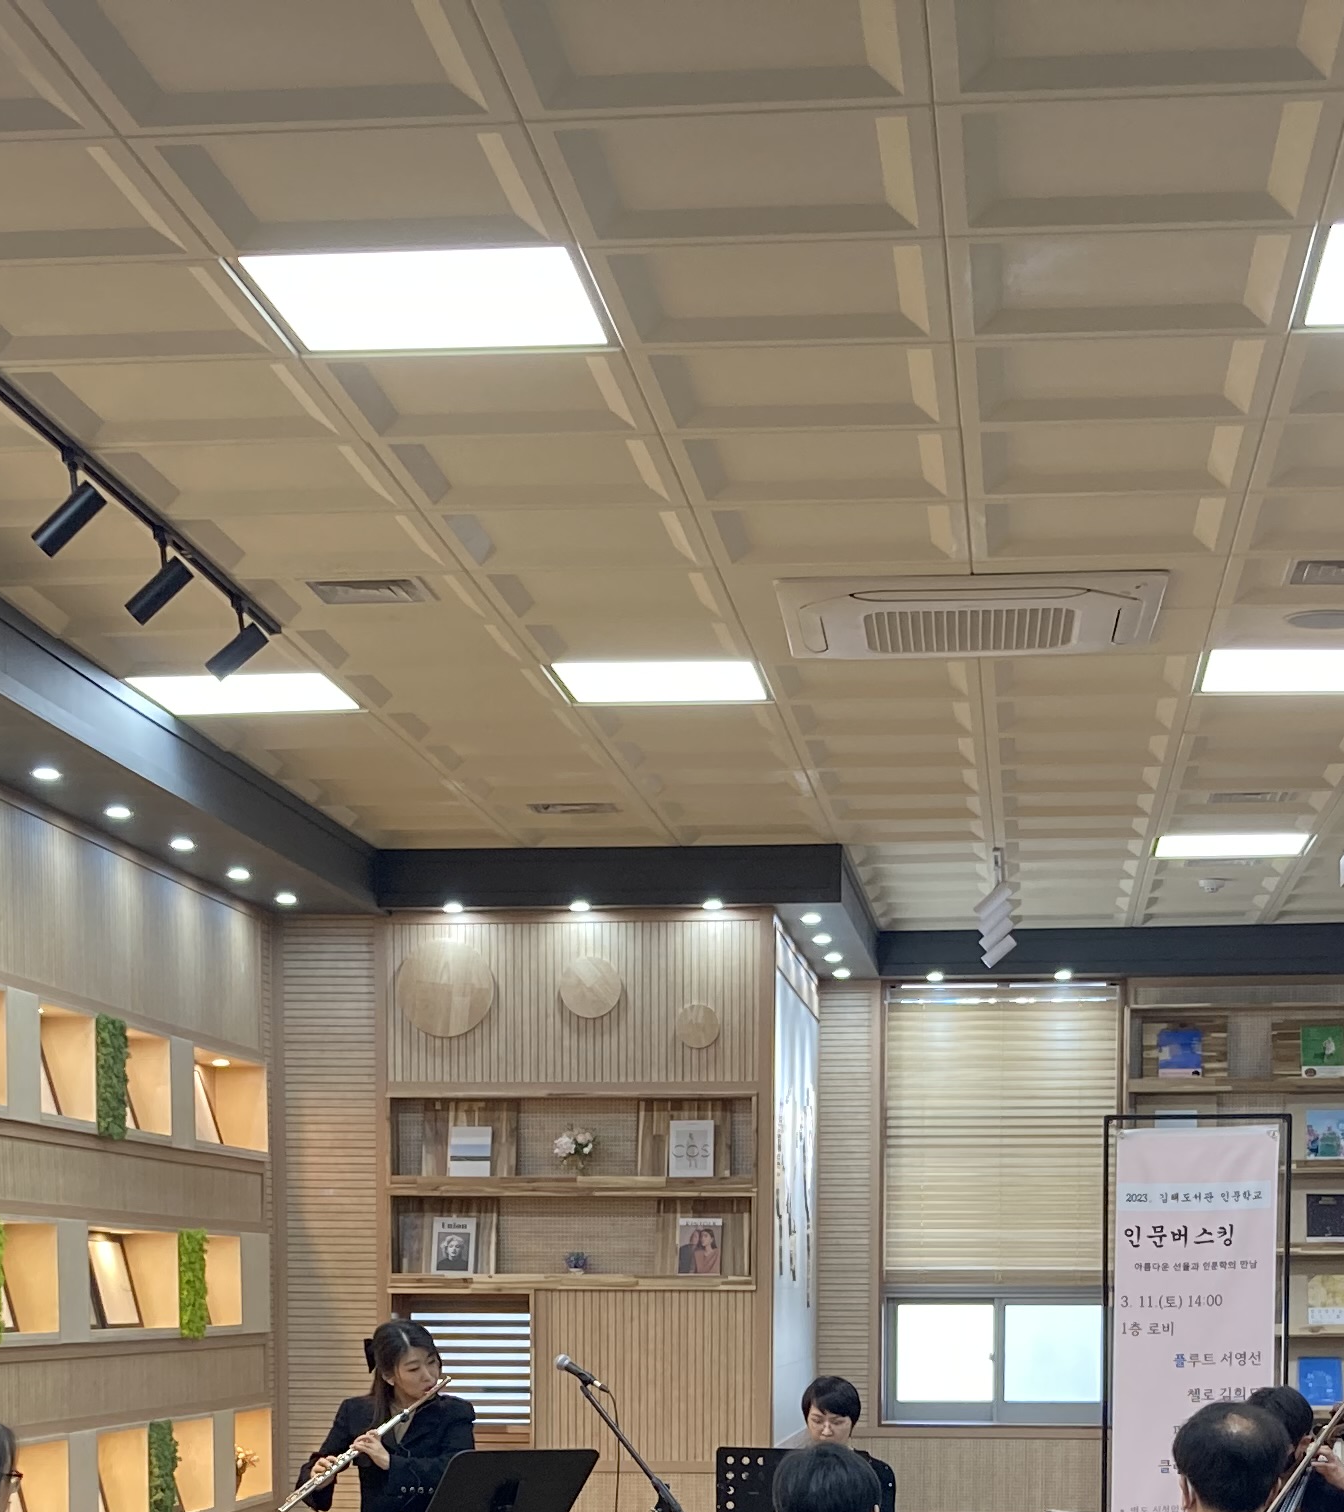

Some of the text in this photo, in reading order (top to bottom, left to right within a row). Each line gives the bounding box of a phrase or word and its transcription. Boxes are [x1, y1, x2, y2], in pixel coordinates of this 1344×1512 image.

[672, 1143, 711, 1158] COS
[1188, 1293, 1223, 1308] 14:00
[1121, 1321, 1175, 1337] 1층 로비
[1173, 1350, 1262, 1369] 플루트 서영선
[1187, 1387, 1259, 1403] 첼로 김희
